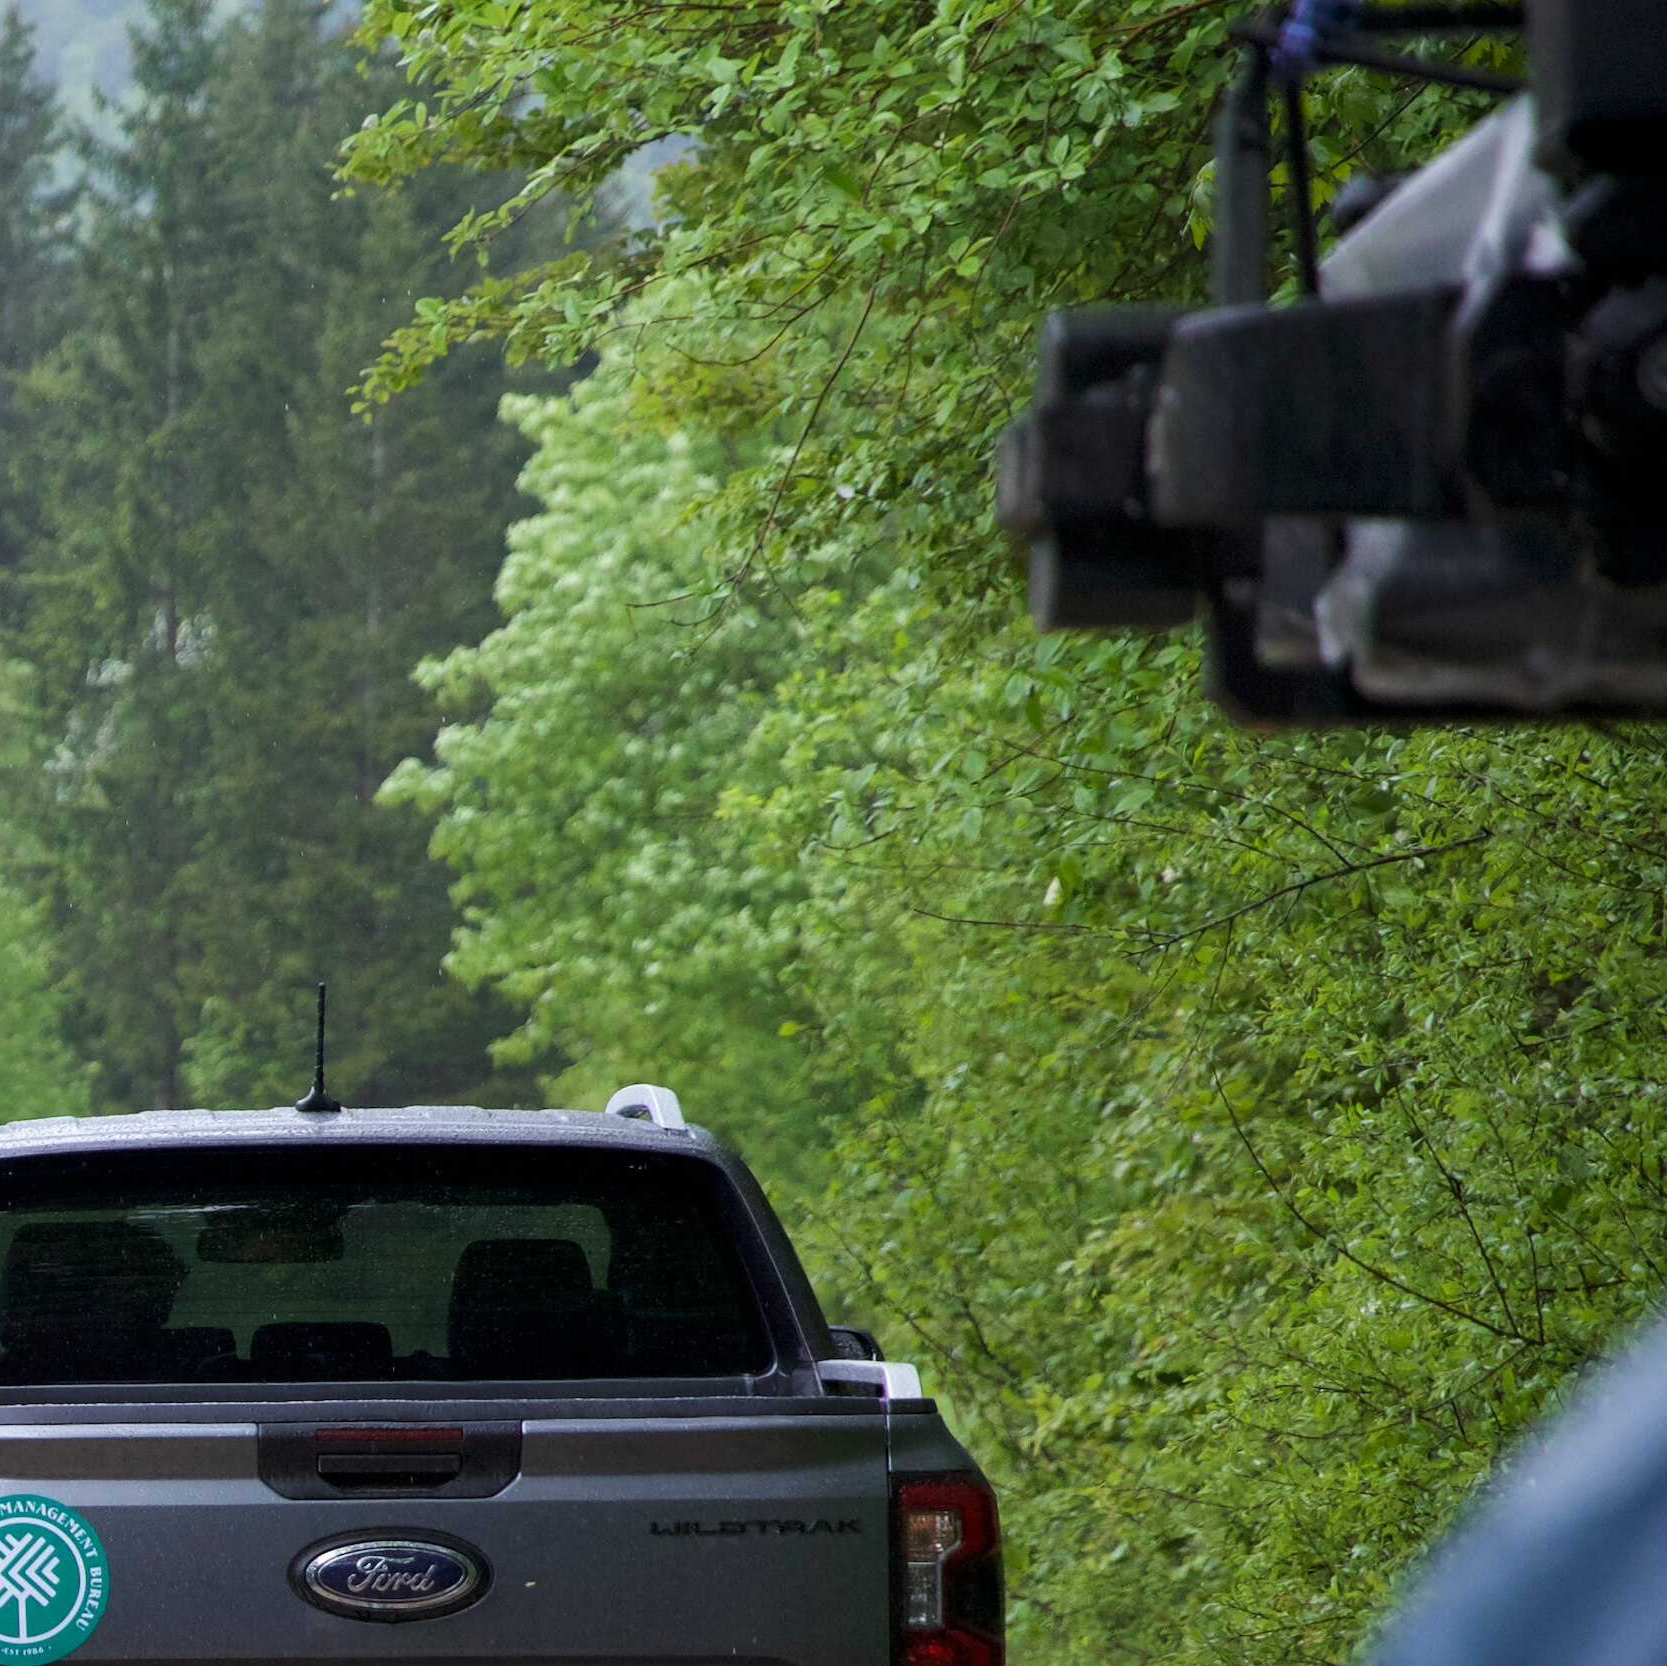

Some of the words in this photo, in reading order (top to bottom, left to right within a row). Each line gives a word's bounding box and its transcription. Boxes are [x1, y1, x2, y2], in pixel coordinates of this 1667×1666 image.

[649, 1517, 864, 1537] WILDTRAK
[347, 1555, 438, 1593] Ford
[75, 1566, 103, 1631] BUREAU
